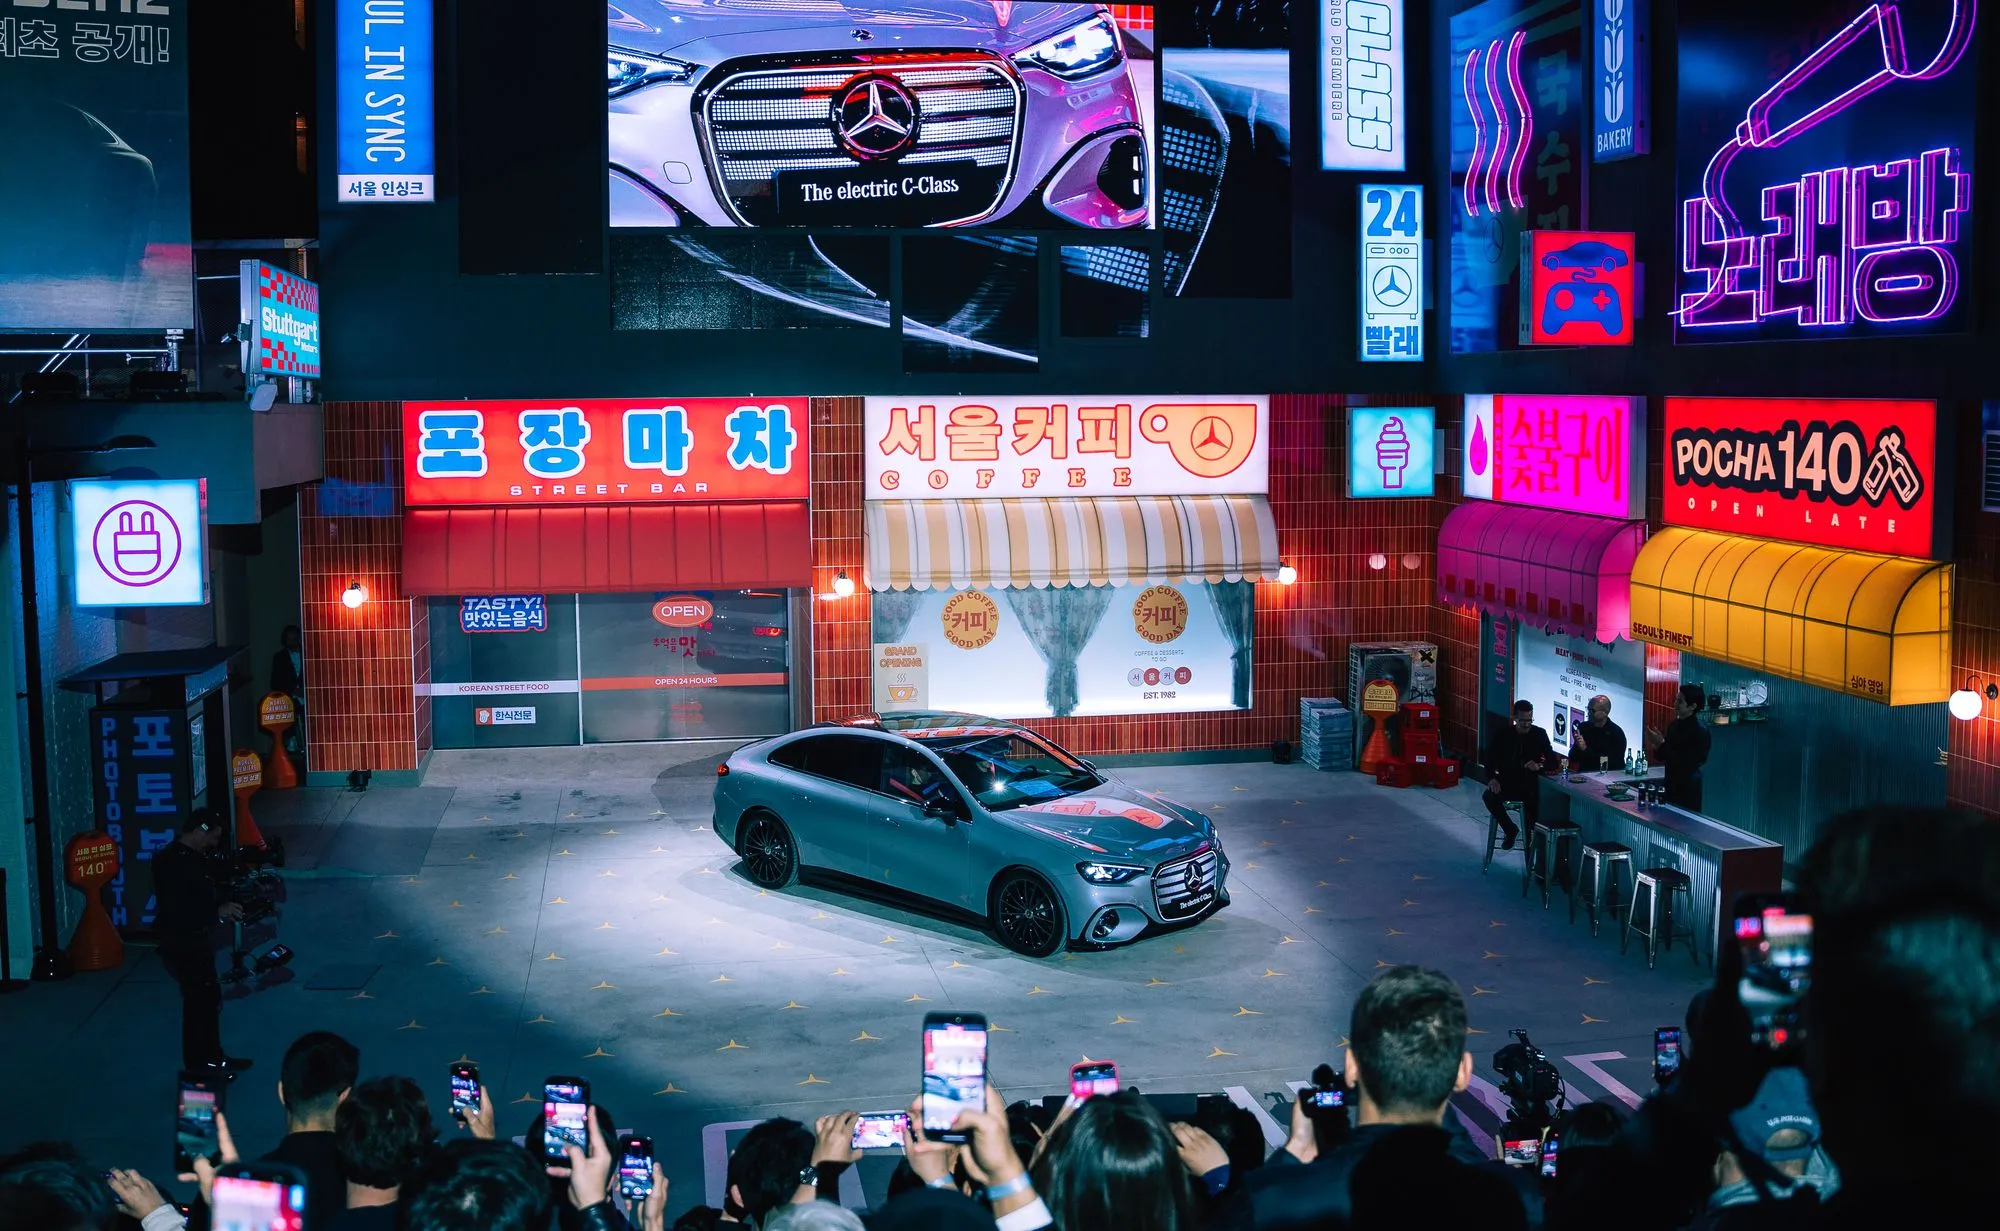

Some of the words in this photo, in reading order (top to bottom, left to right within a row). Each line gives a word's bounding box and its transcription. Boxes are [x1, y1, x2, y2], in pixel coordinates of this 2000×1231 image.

[72, 22, 170, 65] 공개!
[364, 45, 405, 81] IN
[1331, 36, 1343, 121] PREMIERE
[365, 91, 406, 163] SYNC
[1597, 126, 1633, 153] BAKERY
[348, 181, 377, 197] 서울
[381, 181, 424, 197] 인싱크
[801, 182, 833, 203] The
[836, 179, 898, 200] electric
[901, 176, 960, 197] C-Class
[1366, 189, 1418, 237] 24
[1680, 146, 1970, 327] 노래방
[262, 306, 318, 346] Stuttgart
[1365, 325, 1419, 356] 빨래
[416, 405, 798, 479] 포장마차
[878, 403, 1132, 462] 서울커피
[1508, 405, 1623, 502] 숯불구이
[509, 484, 628, 497] STREET
[651, 482, 709, 495] BAR
[879, 467, 1132, 490] COFFEE
[1688, 497, 1764, 518] OPEN
[1805, 510, 1896, 533] LATE
[464, 597, 542, 611] TASTY!
[661, 605, 705, 617] OPEN
[943, 594, 964, 621] GOOD
[966, 591, 998, 621] COFFEE
[1134, 589, 1154, 616] GOOD
[1157, 587, 1187, 616] COFFEE
[464, 610, 543, 628] 맛있는음식
[951, 611, 987, 632] 커피
[1142, 605, 1177, 626] 커피
[946, 630, 974, 648] GOOD
[976, 628, 994, 647] DAY
[1137, 624, 1163, 642] GOOD
[1165, 623, 1184, 641] DAY
[1632, 622, 1664, 640] SEOUL'S
[1664, 629, 1693, 647] FINEST
[879, 657, 922, 668] OPENING
[884, 646, 917, 657] GRAND
[459, 685, 493, 693] KOREAN
[494, 684, 525, 692] STREET
[526, 683, 550, 691] FOOD
[655, 678, 678, 686] OPEN
[690, 676, 718, 684] HOURS
[1851, 675, 1867, 690] 심야
[1868, 678, 1884, 695] 영업
[1143, 692, 1159, 700] EST.
[1160, 691, 1177, 699] 1982
[495, 710, 532, 721] 한식전문
[101, 717, 127, 926] PHOTOBTH
[78, 862, 104, 877] 140
